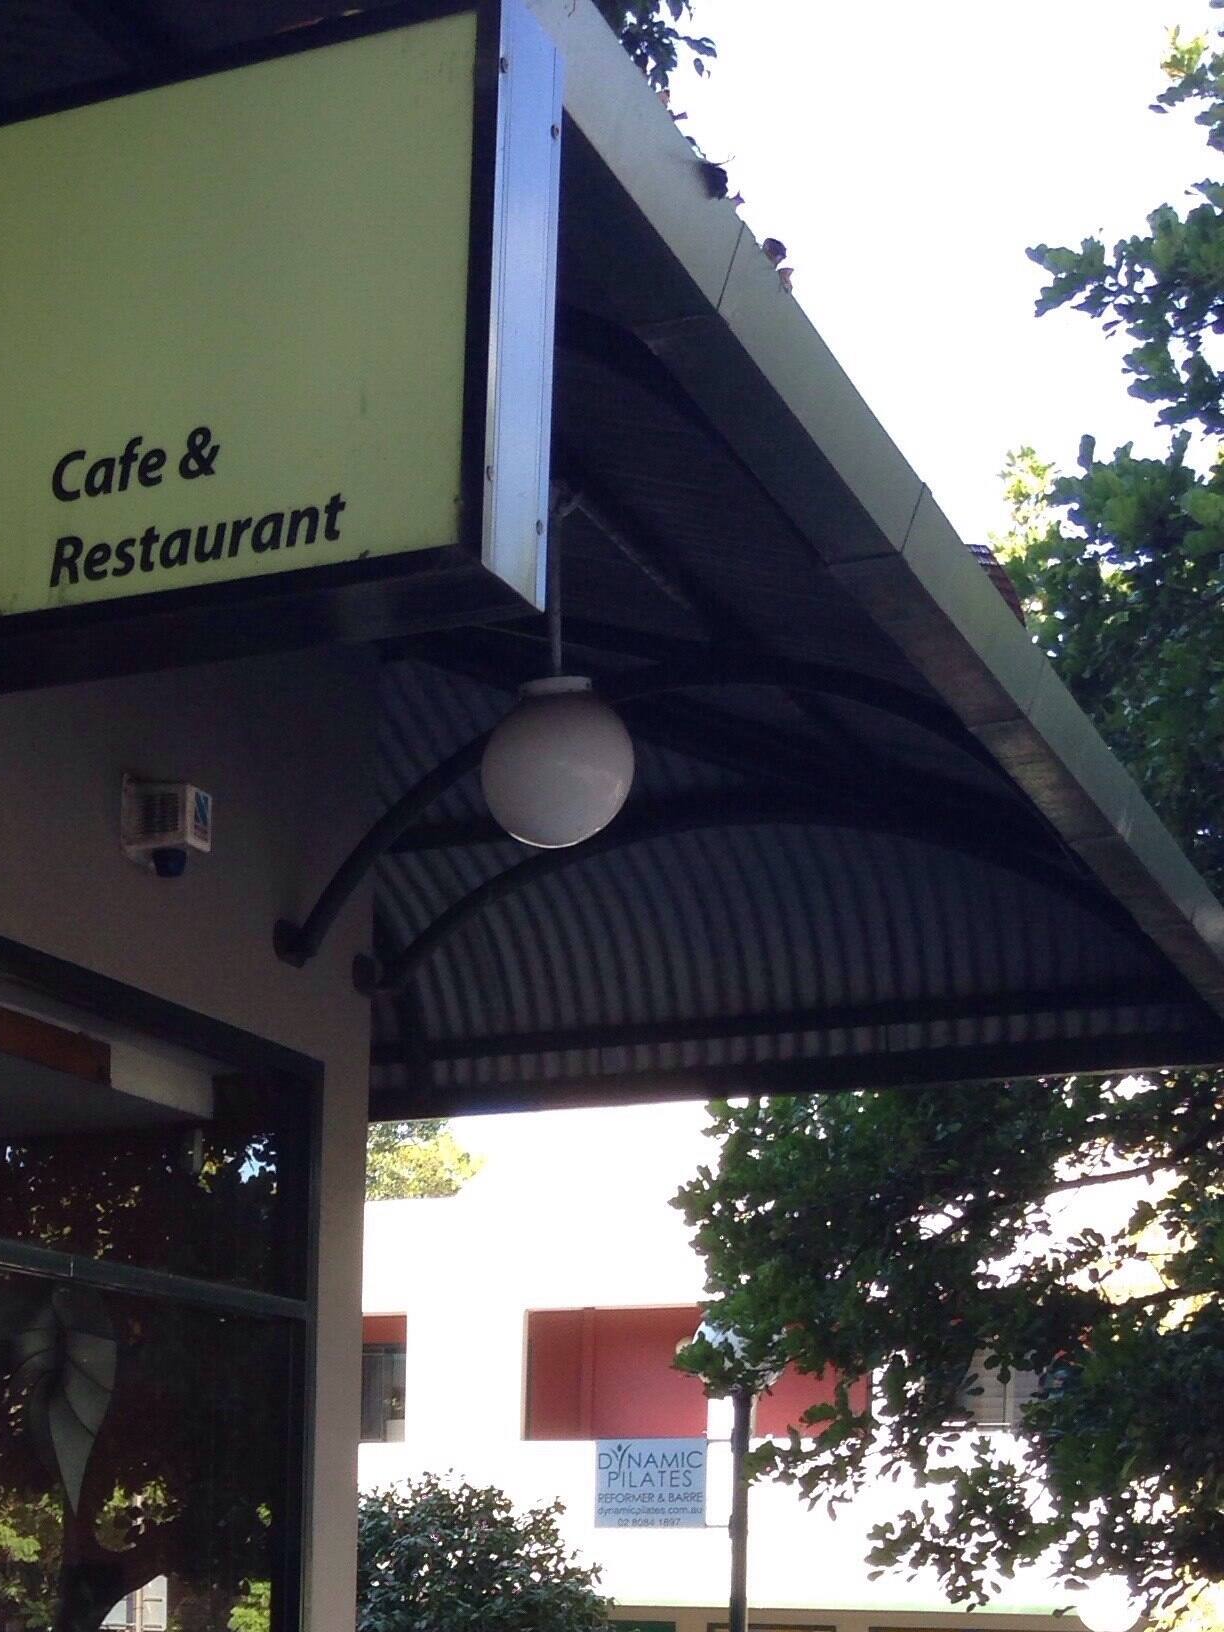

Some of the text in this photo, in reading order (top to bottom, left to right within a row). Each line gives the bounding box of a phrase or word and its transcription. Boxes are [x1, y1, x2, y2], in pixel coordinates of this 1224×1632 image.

[51, 426, 220, 502] Cafe &
[49, 492, 347, 588] Restaurant
[598, 1446, 703, 1471] DYNAMIC
[608, 1469, 693, 1488] PILATES
[598, 1492, 655, 1504] REFORMER
[668, 1491, 703, 1503] BARRE
